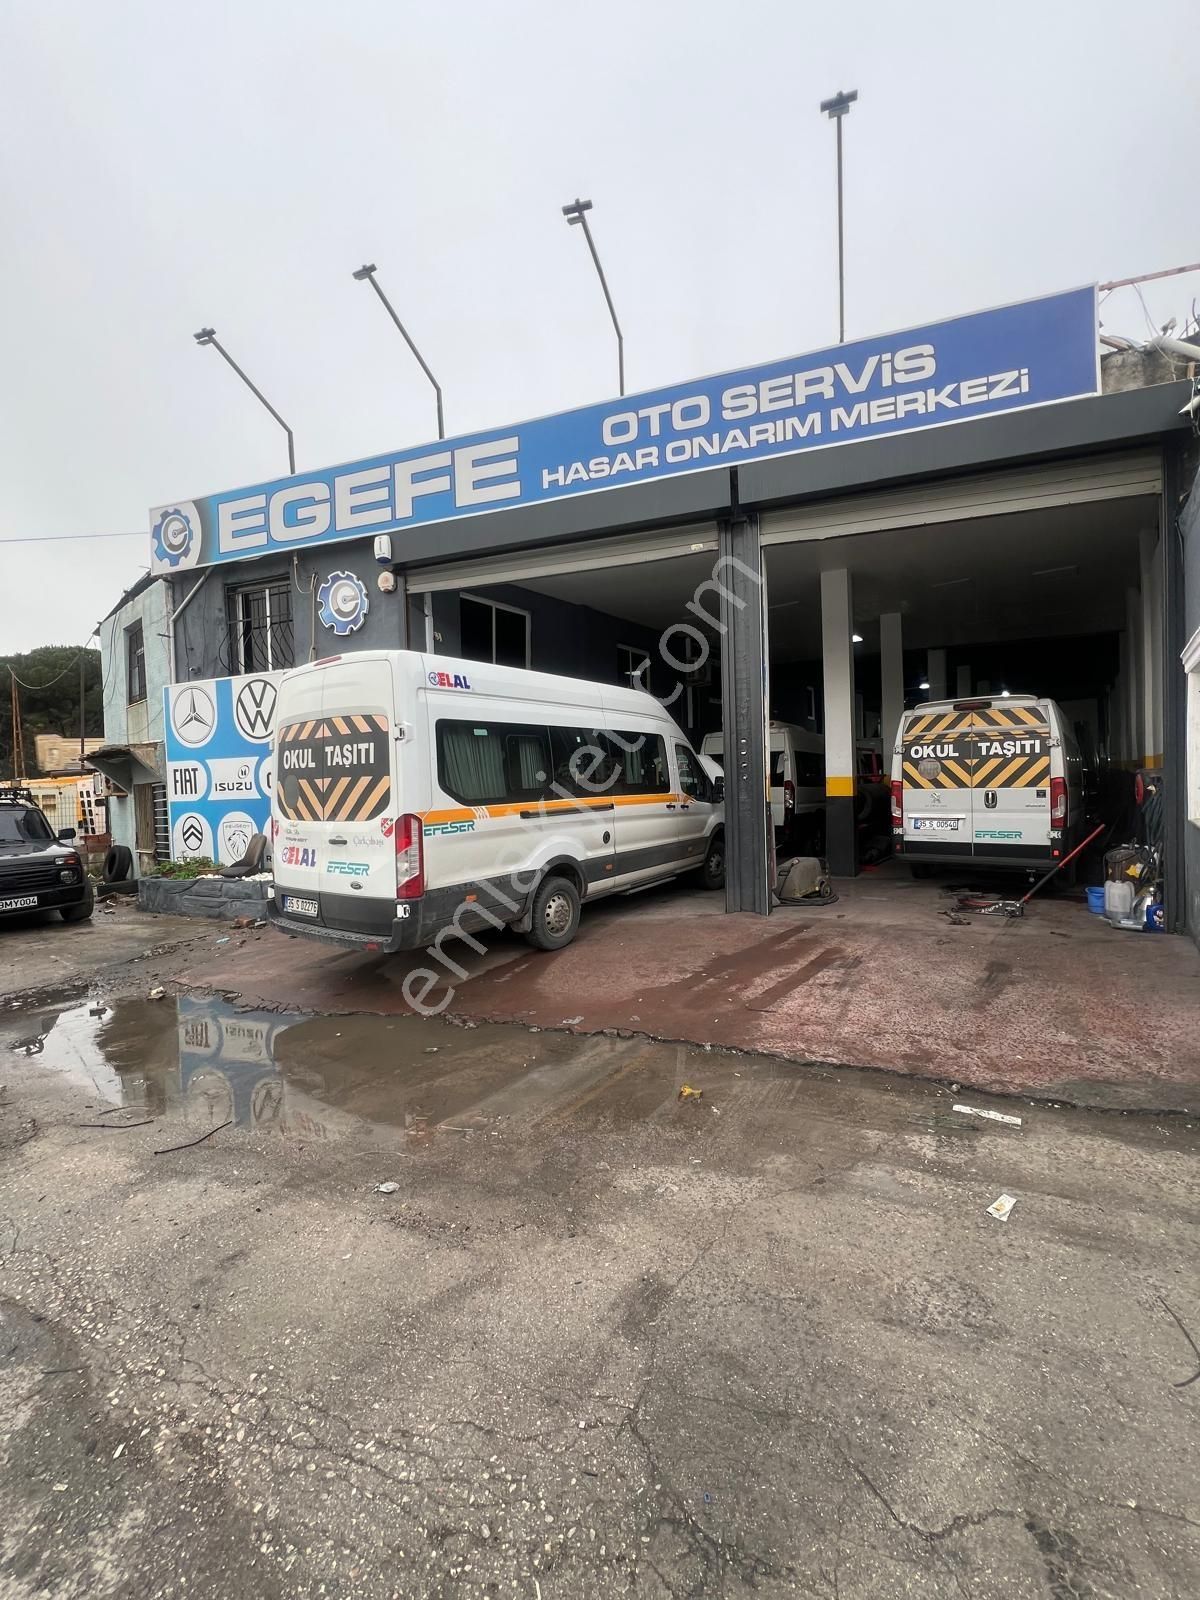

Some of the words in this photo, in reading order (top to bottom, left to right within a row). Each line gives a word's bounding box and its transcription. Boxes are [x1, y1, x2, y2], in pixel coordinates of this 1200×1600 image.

[602, 394, 711, 446] OTO
[541, 446, 659, 489] HASAR
[665, 412, 822, 463] ONARIM
[217, 435, 522, 554] EGEFE
[437, 672, 471, 690] ELAL
[283, 748, 316, 770] OKUL
[324, 742, 375, 768] TAŞITI
[910, 743, 959, 759] OKUL
[977, 739, 1041, 758] TAŞITI
[173, 767, 199, 796] FIAT
[214, 781, 253, 792] ISUZU
[423, 820, 475, 836] EFESER
[918, 820, 927, 828] 35
[928, 820, 934, 828] S
[974, 830, 1023, 839] EFESER
[286, 846, 317, 867] ELAL
[326, 861, 370, 876] EFESER
[287, 898, 294, 909] 35
[295, 899, 300, 910] S
